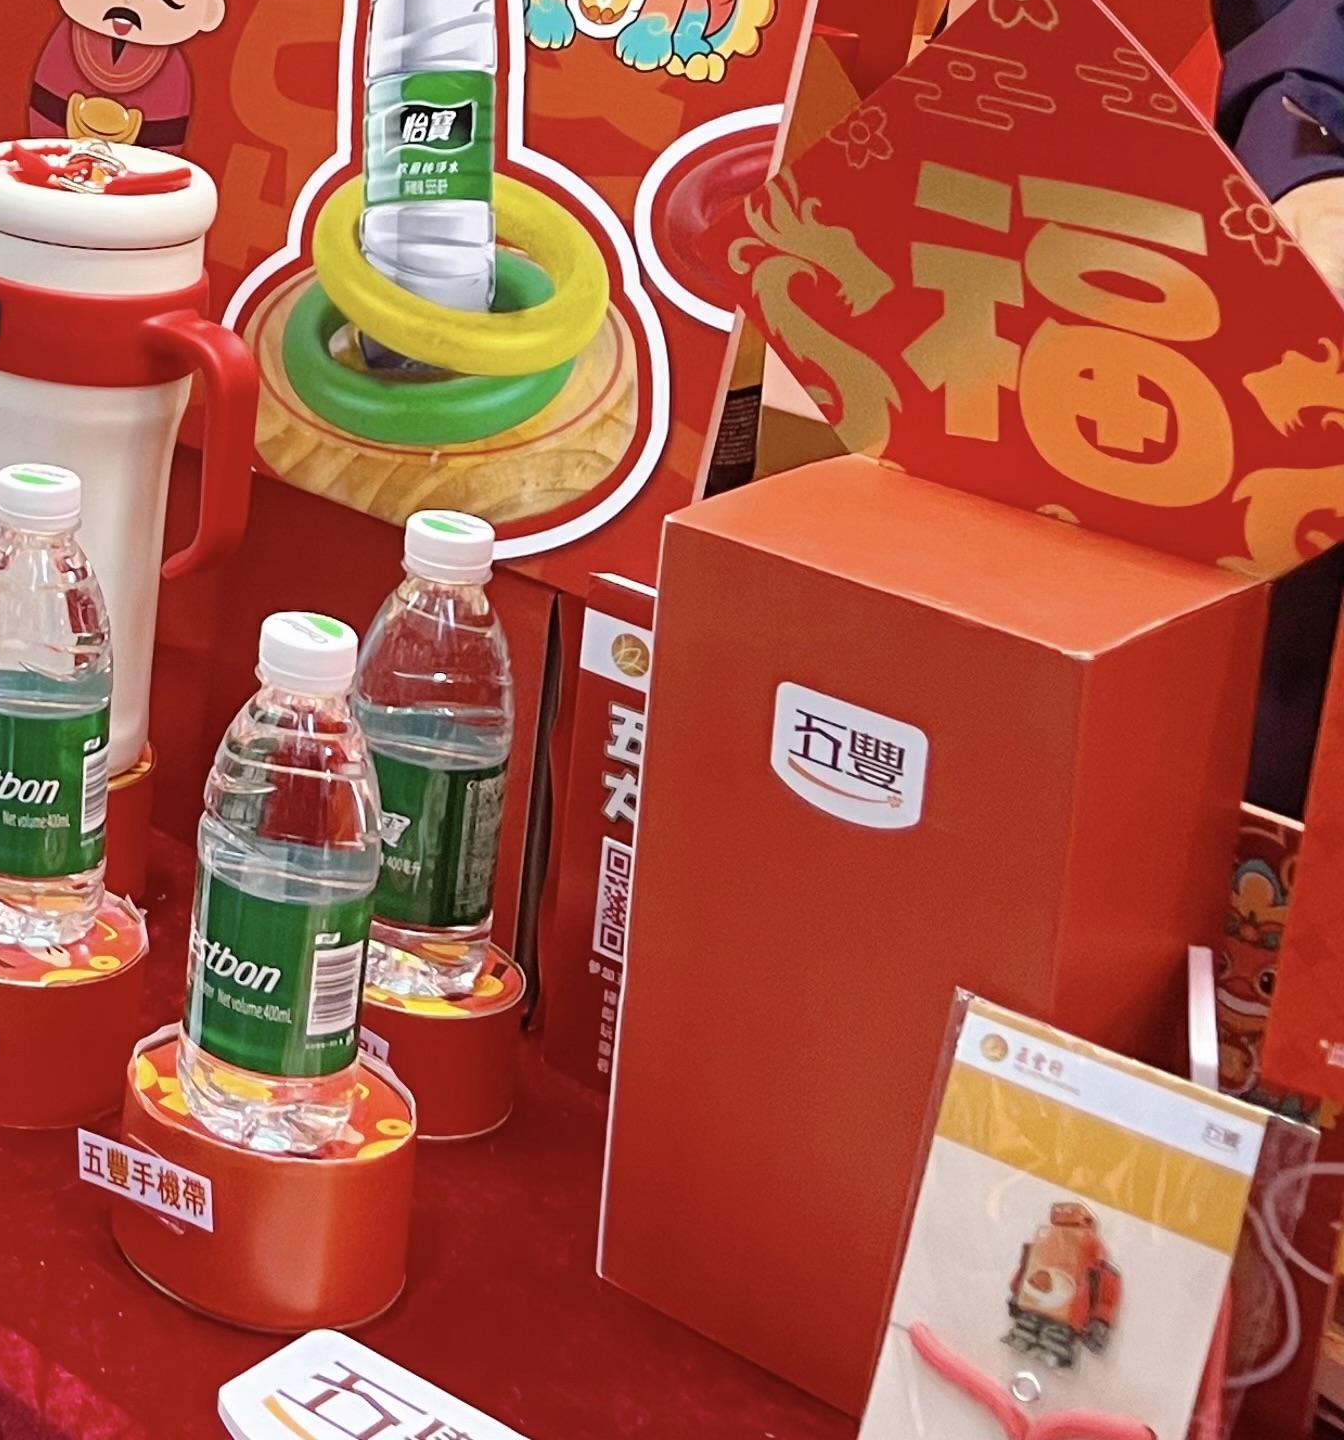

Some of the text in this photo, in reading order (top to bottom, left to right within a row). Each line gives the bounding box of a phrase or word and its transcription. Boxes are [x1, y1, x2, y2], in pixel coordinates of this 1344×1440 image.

[401, 110, 457, 143] 怡寶
[787, 708, 906, 796] 五豐
[81, 1142, 207, 1219] 五豐手機帶
